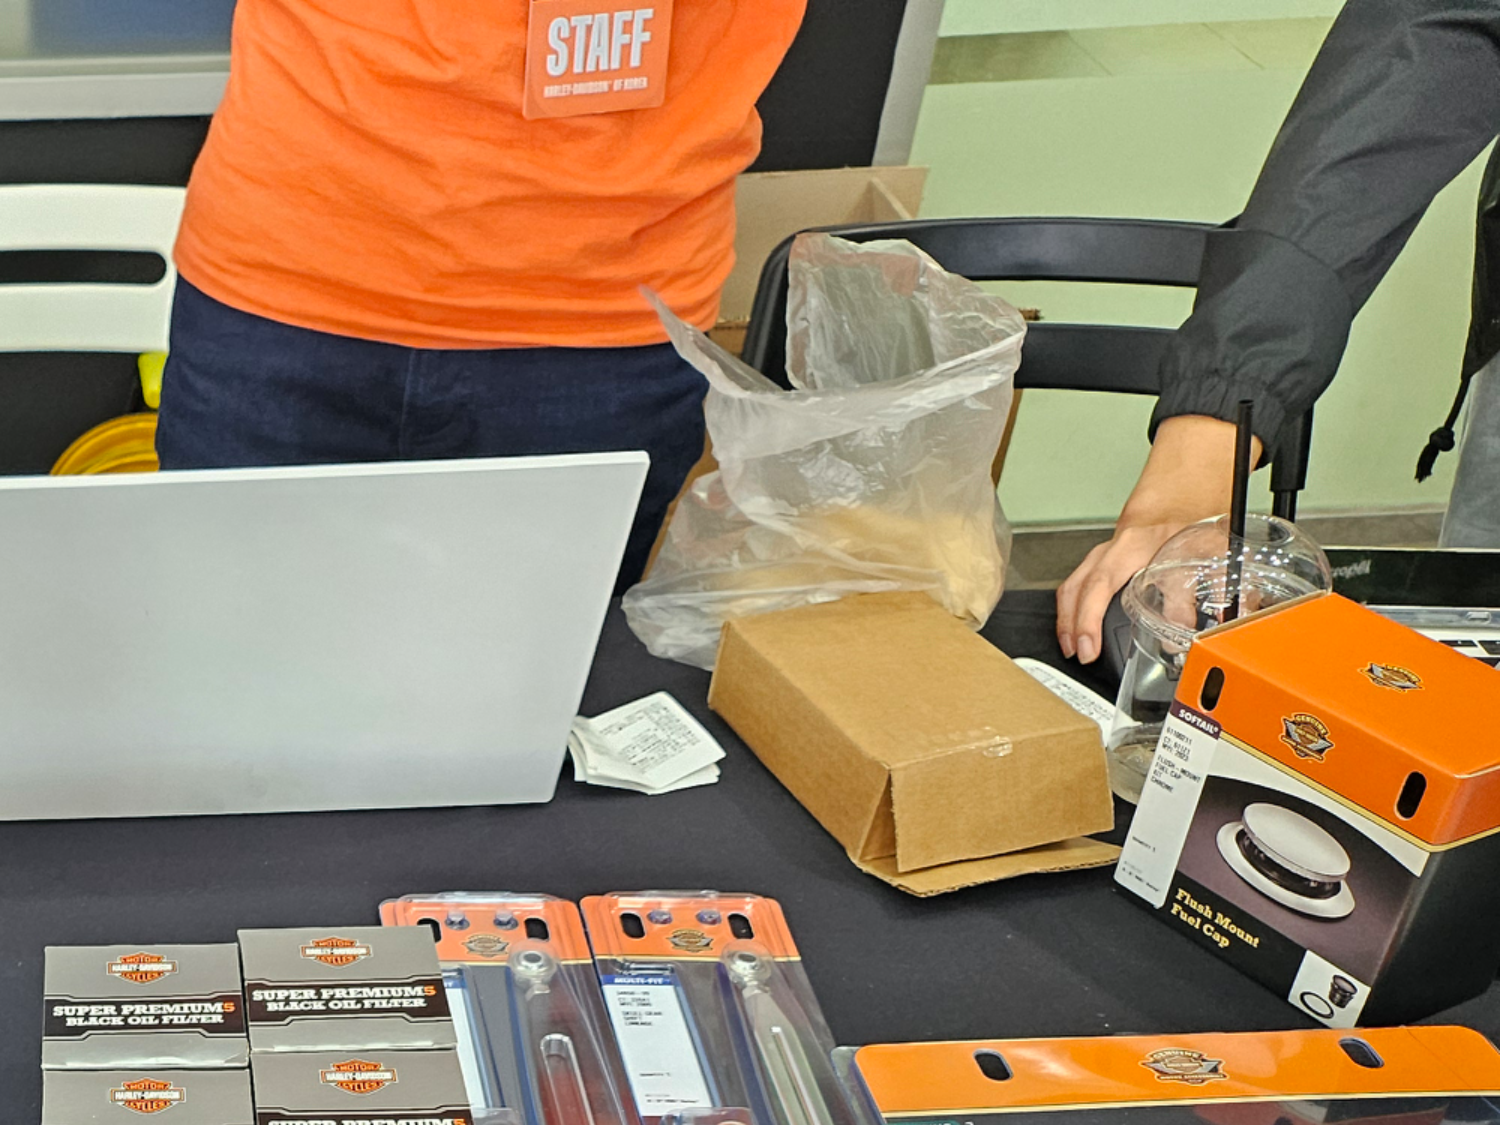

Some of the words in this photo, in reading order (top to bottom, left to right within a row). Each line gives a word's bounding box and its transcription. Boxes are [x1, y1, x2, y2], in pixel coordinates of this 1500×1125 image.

[546, 8, 654, 77] STAFF
[1170, 902, 1202, 930] Fuel
[1202, 923, 1230, 948] Cap
[1175, 888, 1213, 920] Flush
[1214, 911, 1259, 948] Mount
[252, 987, 318, 1001] SUPER
[53, 1005, 117, 1017] SUPER
[267, 1000, 327, 1011] BLACK
[328, 999, 362, 1010] OIL
[363, 998, 427, 1009] FILTER
[66, 1016, 125, 1026] BLACK
[127, 1015, 160, 1025] OIL
[161, 1014, 224, 1024] FILTER
